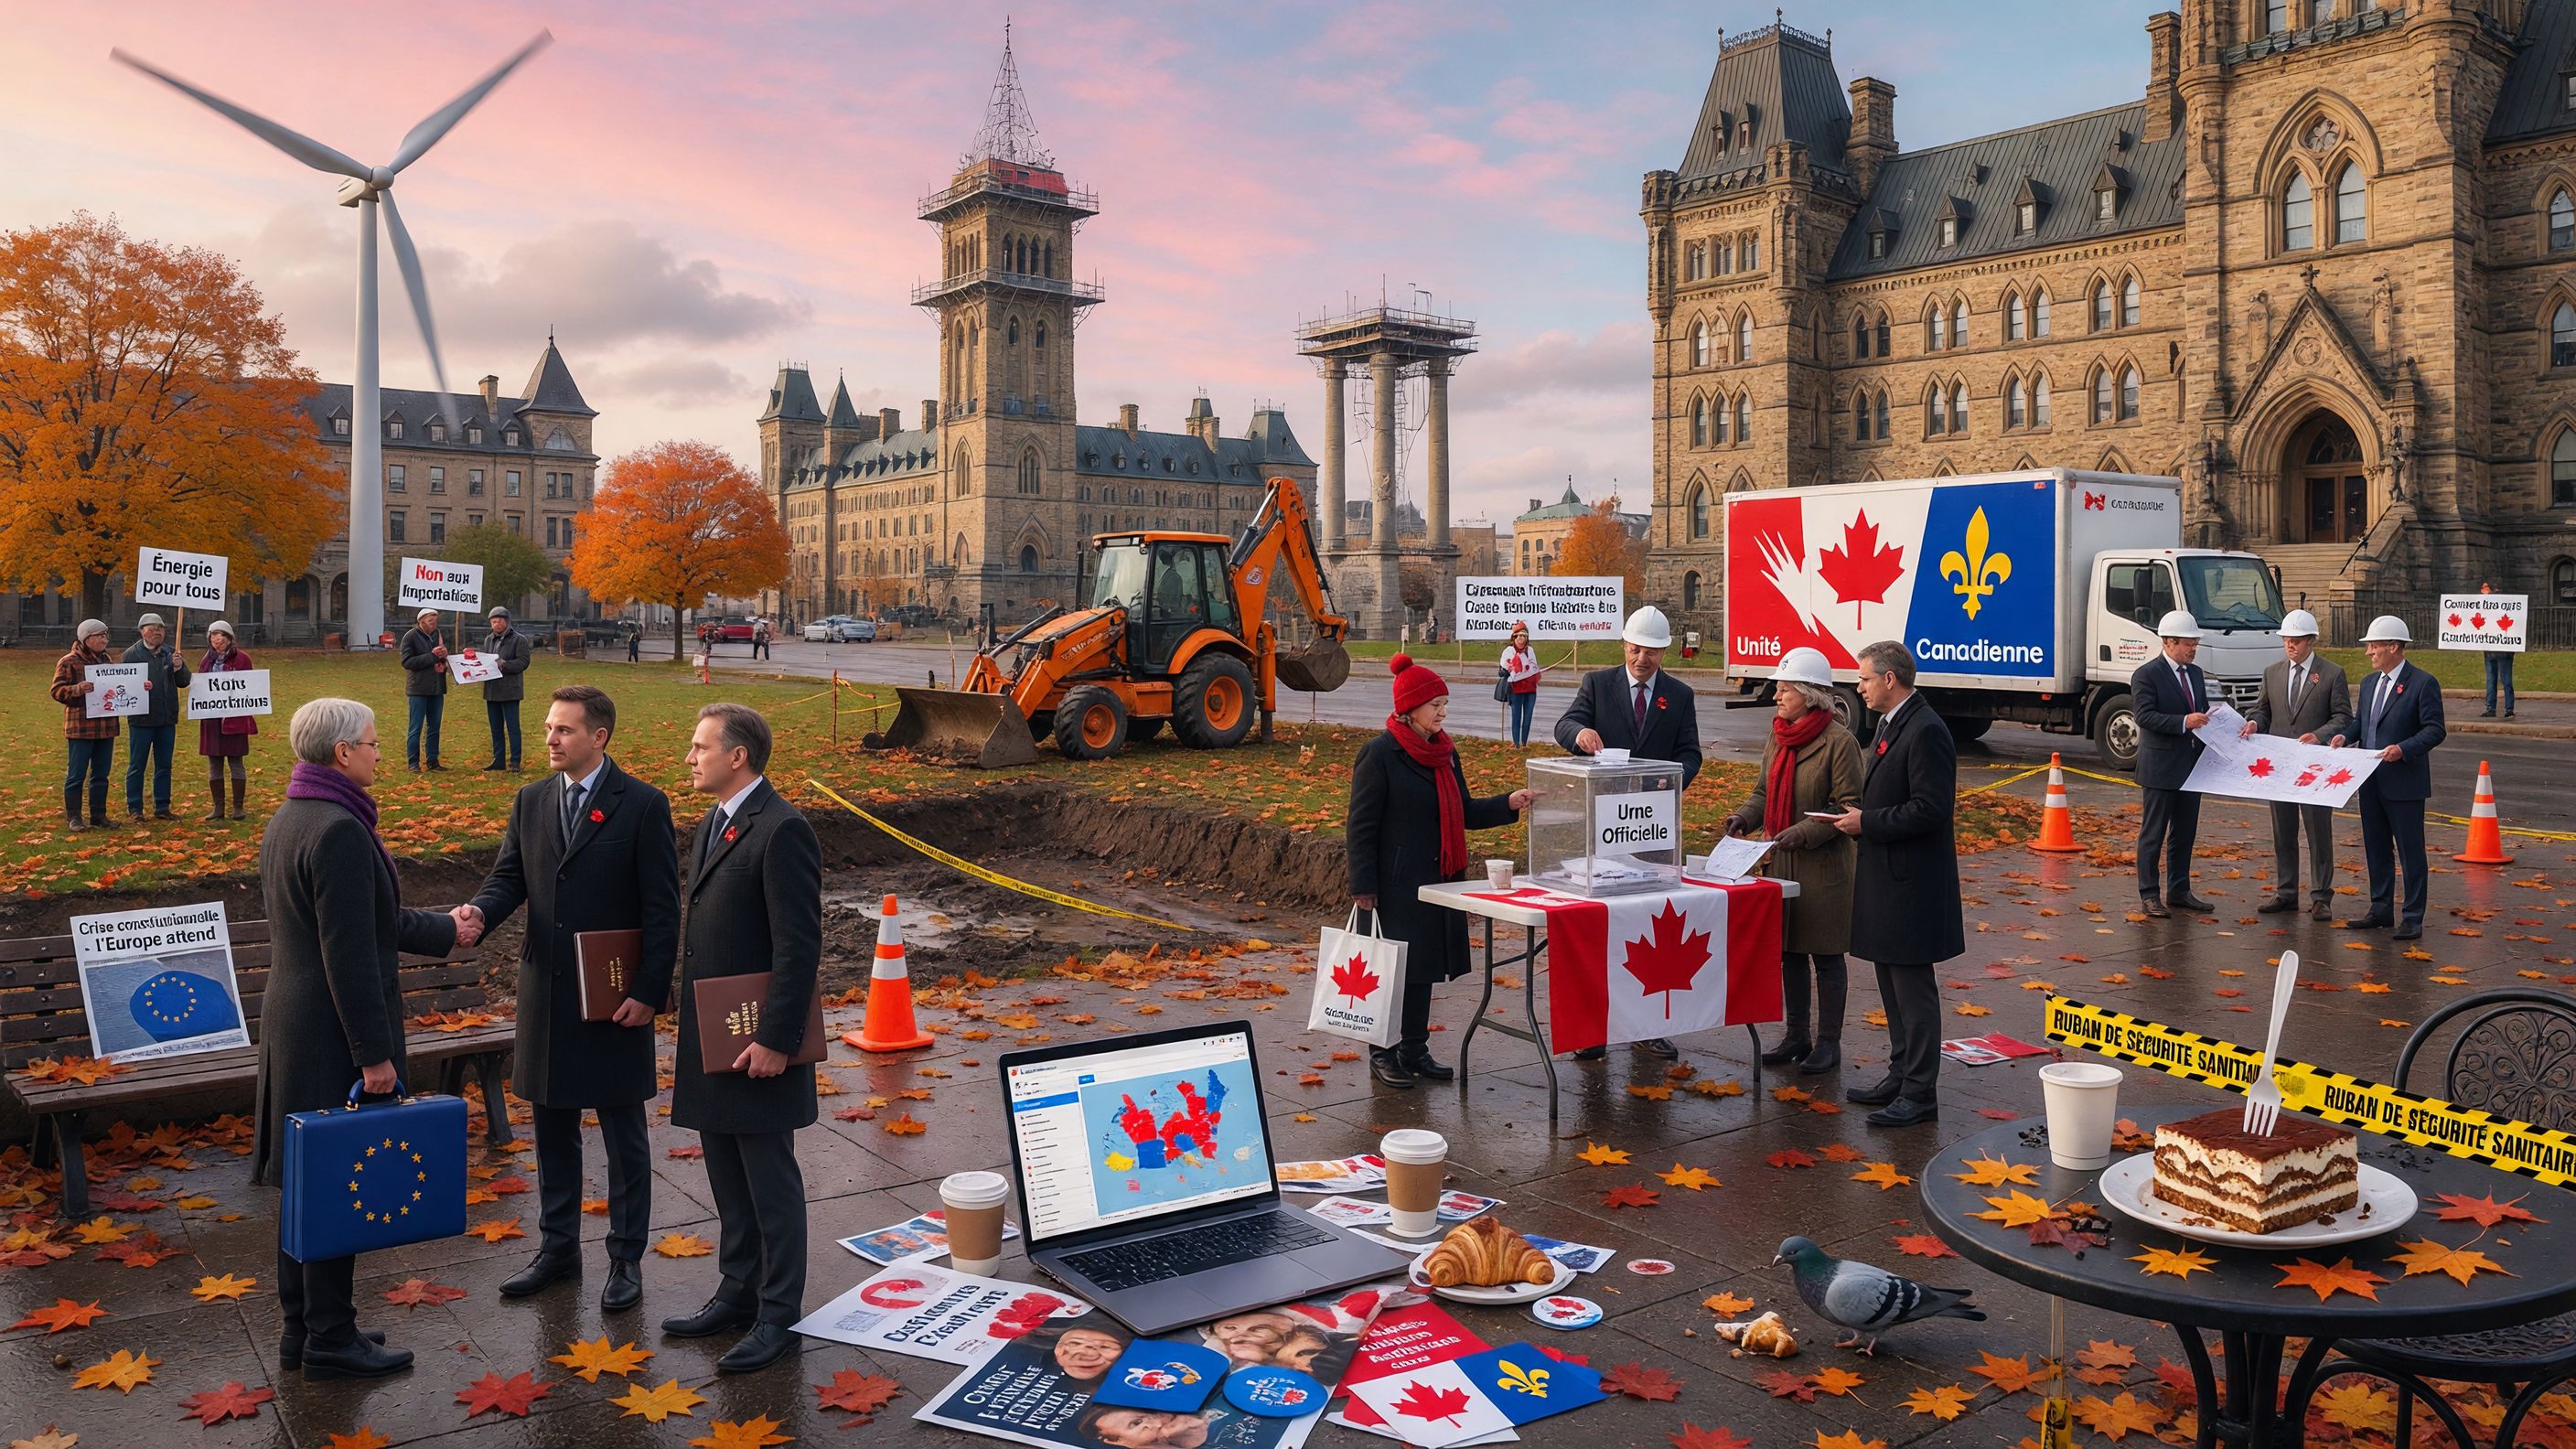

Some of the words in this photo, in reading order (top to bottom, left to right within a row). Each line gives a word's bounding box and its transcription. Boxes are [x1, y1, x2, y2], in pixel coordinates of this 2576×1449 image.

[153, 553, 213, 580] Énergie
[415, 564, 444, 582] Non
[143, 581, 182, 597] pour
[186, 582, 220, 600] tous
[1736, 635, 1781, 657] Unité
[1916, 638, 2044, 663] Canadienne
[1618, 804, 1653, 821] Urne
[1602, 823, 1668, 844] Officielle
[79, 921, 114, 935] Crise
[95, 934, 163, 952] l'Europe
[166, 926, 217, 945] attend
[2053, 1008, 2102, 1041] RUBAN
[2105, 1023, 2122, 1047] DE
[2324, 1084, 2379, 1121] RUBAN
[2381, 1100, 2403, 1127] DE
